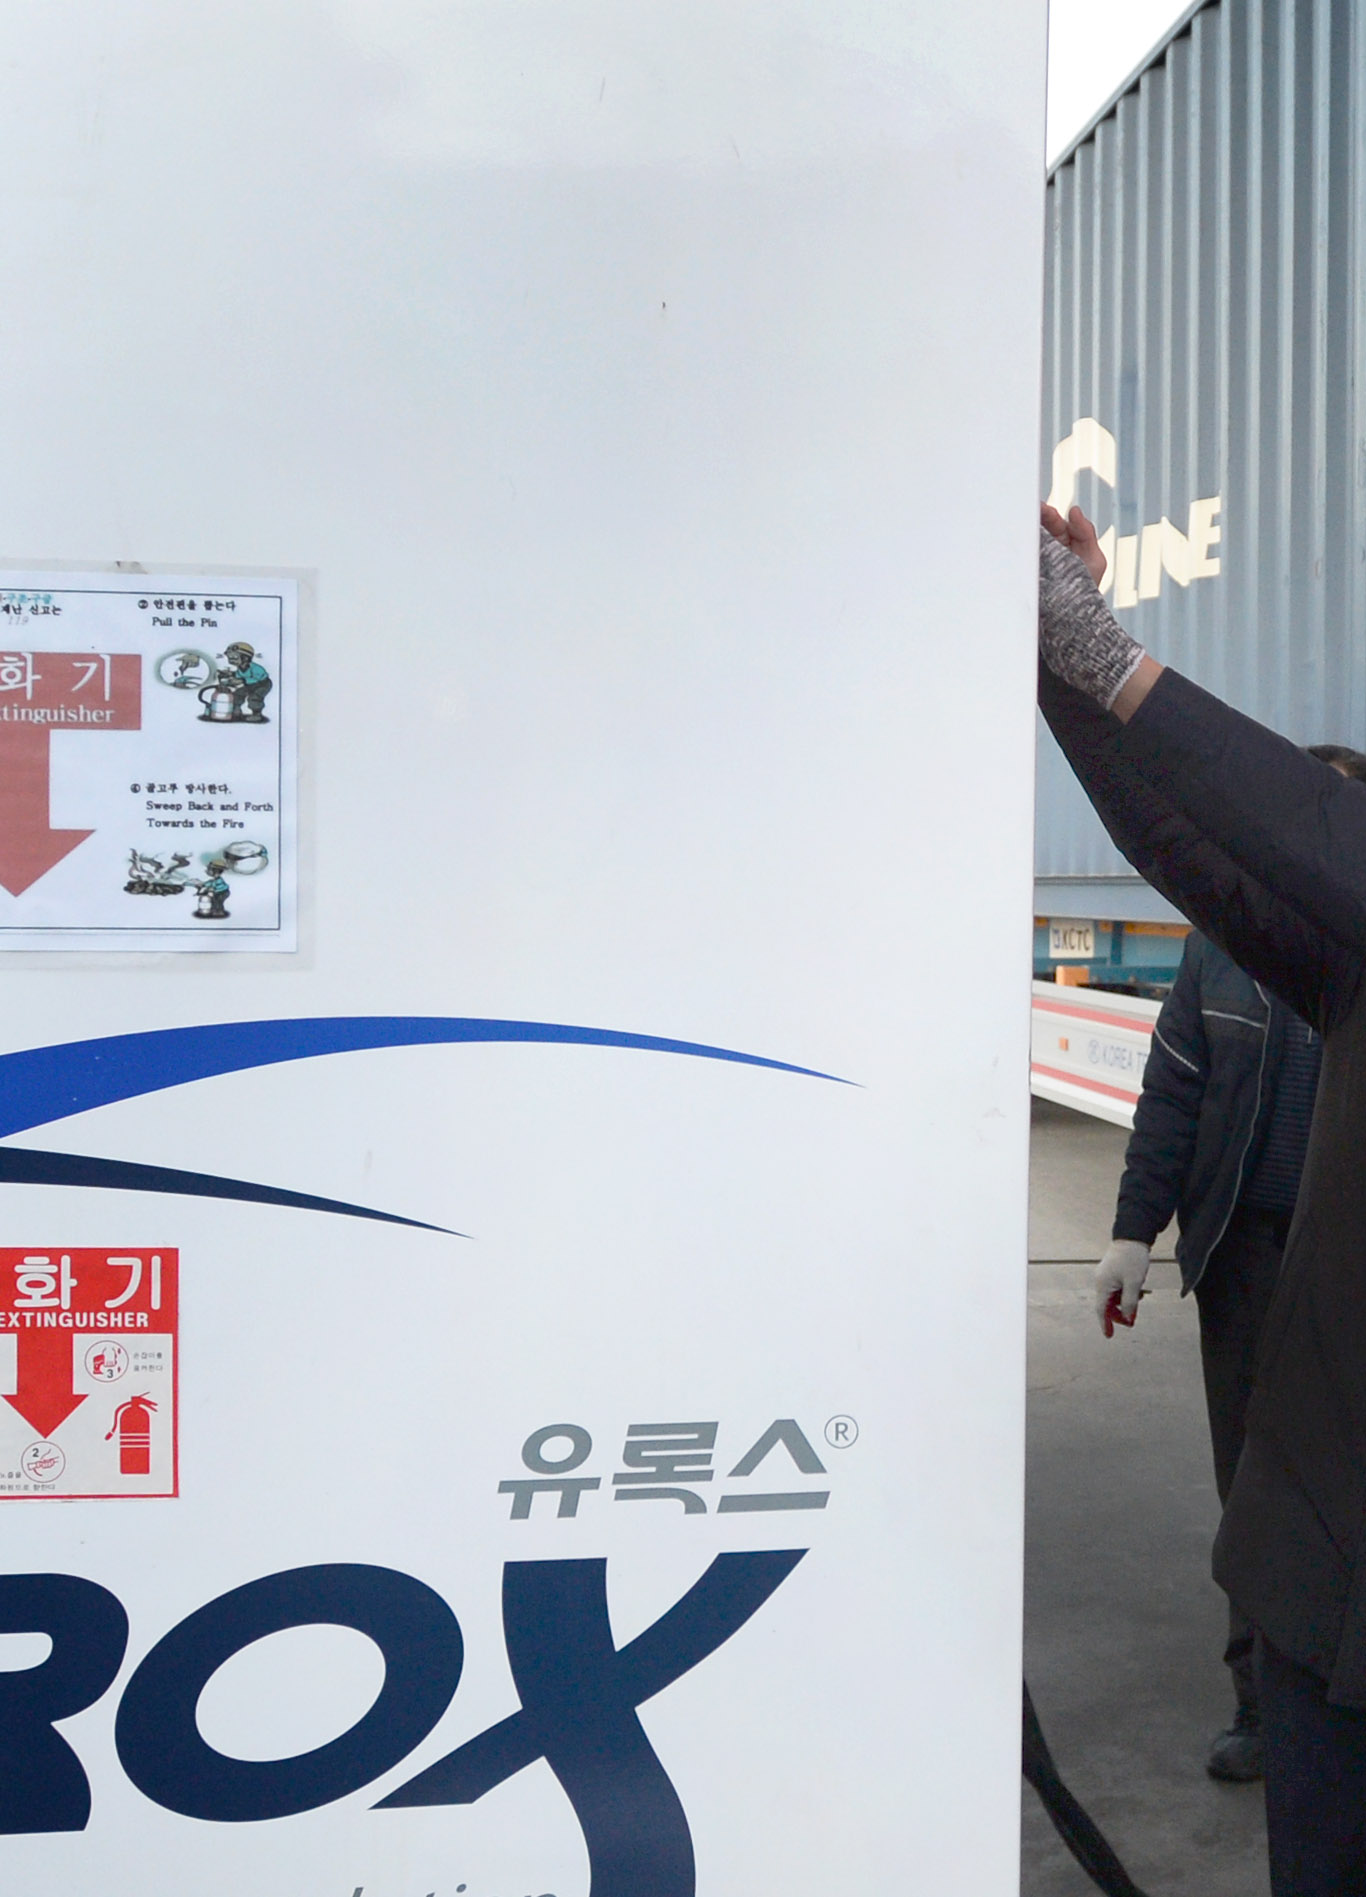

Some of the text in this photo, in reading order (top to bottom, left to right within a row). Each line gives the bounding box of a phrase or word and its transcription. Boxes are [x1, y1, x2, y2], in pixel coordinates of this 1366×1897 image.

[152, 617, 218, 628] Pull the Pin
[0, 703, 115, 724] tinguisher
[146, 800, 274, 812] Sweep Back and Forth
[146, 818, 245, 829] Towards the Fire
[106, 1368, 114, 1379] 3
[32, 1447, 40, 1458] 2
[497, 1418, 831, 1521] 유록스
